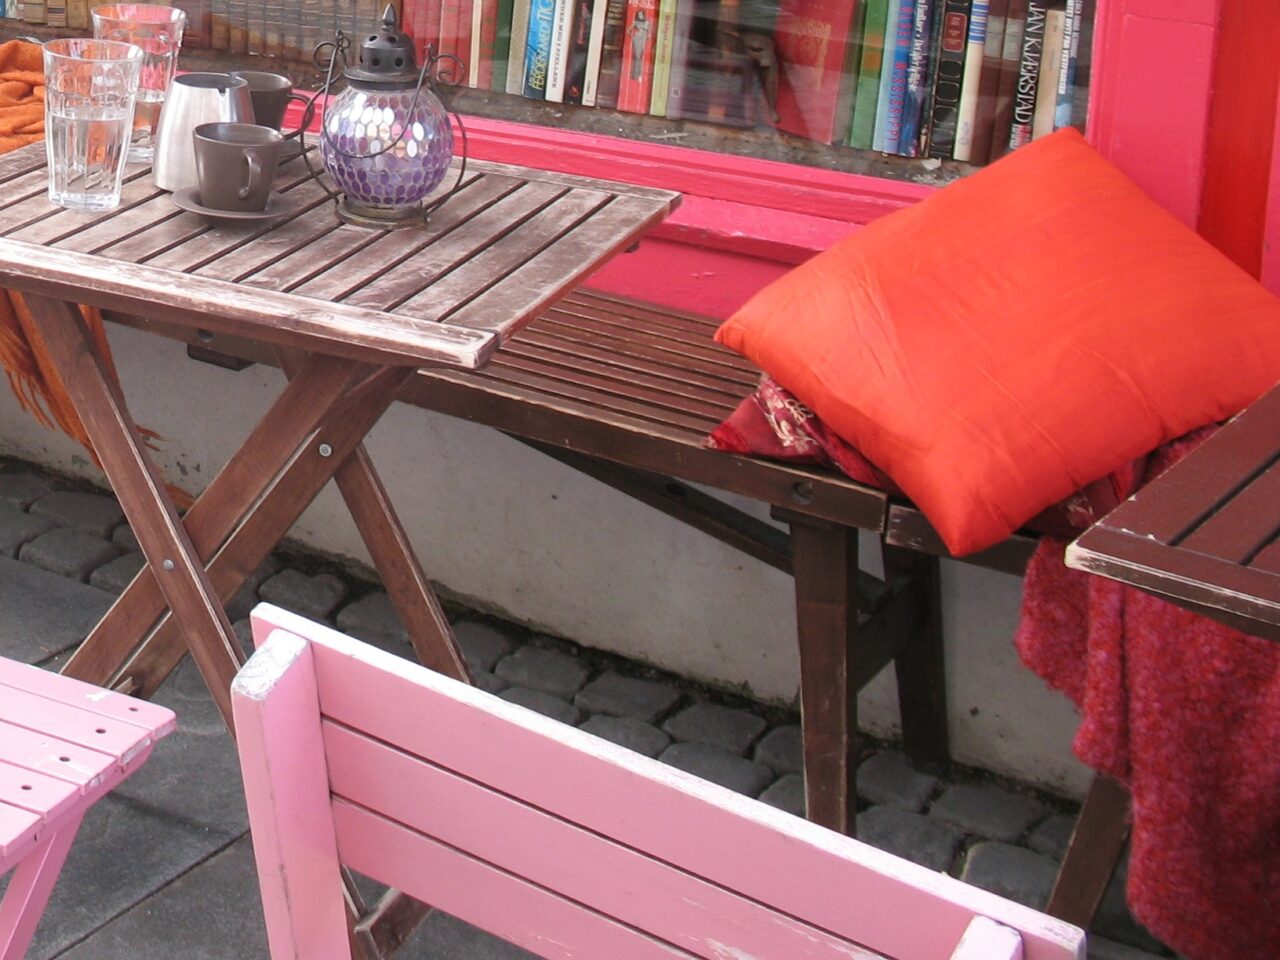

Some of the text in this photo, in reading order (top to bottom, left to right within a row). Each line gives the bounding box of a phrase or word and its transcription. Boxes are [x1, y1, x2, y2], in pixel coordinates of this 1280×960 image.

[663, 15, 671, 40] Bridget
[917, 6, 928, 32] Faulkner
[1027, 2, 1046, 34] JAN
[537, 24, 550, 49] MED
[531, 50, 548, 90] FERDEN
[1014, 36, 1042, 123] KJÆRSTAD
[886, 63, 907, 142] MISSISSIPPI
